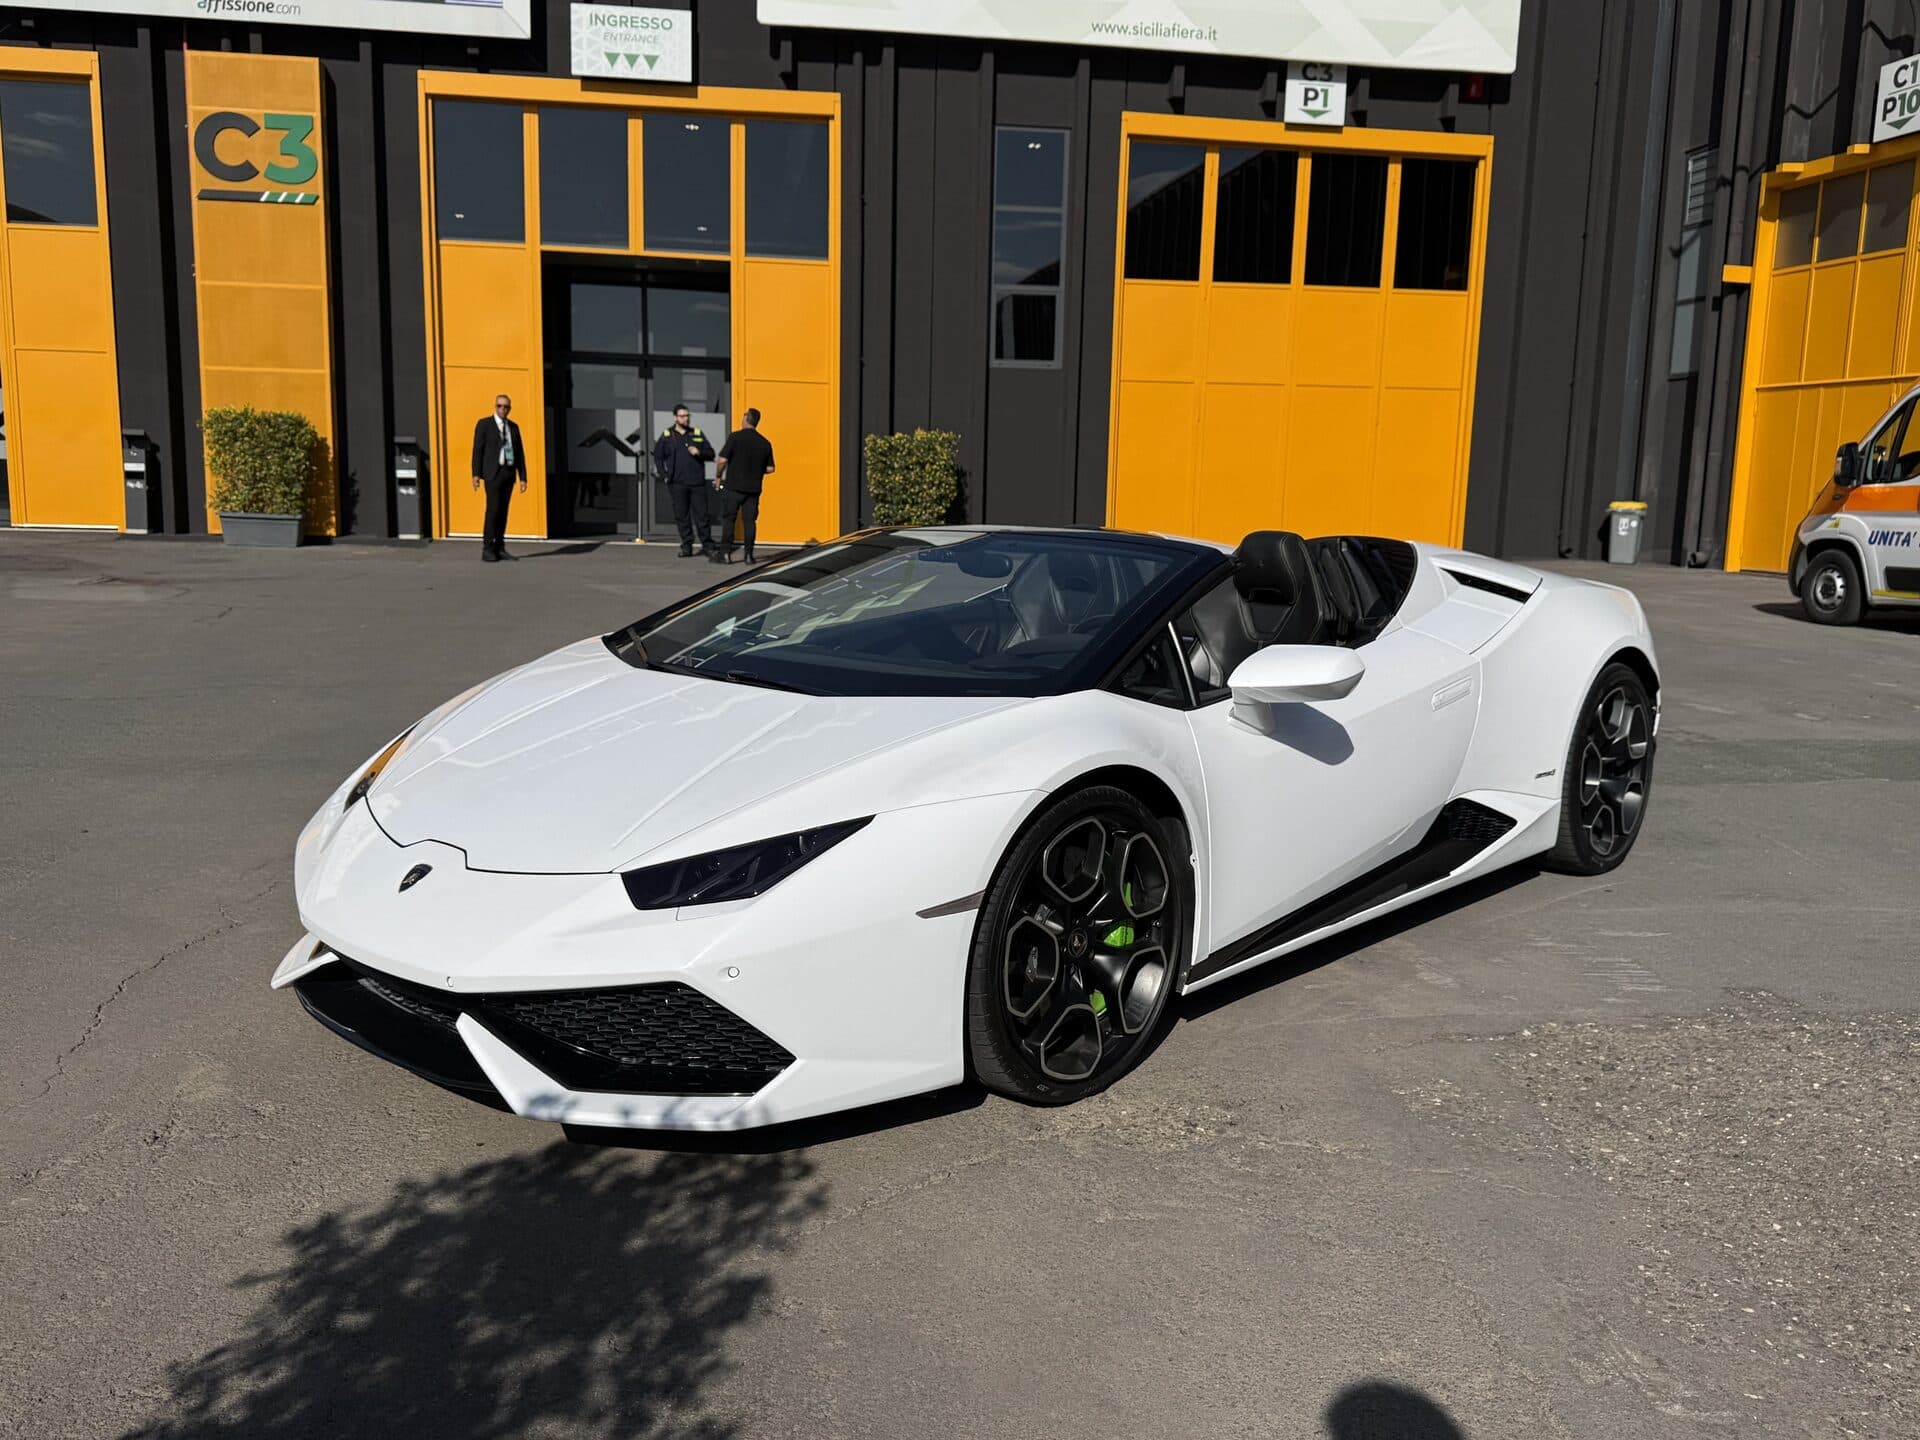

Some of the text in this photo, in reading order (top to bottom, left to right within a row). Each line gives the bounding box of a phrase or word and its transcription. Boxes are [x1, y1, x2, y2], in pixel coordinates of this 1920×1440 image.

[590, 12, 673, 30] INGRESSO
[1091, 21, 1217, 41] www.siciliafiera.it
[603, 32, 660, 44] ENTRANCE
[1302, 63, 1333, 81] C3
[1893, 60, 1919, 88] C1
[1303, 87, 1329, 108] P1
[1882, 88, 1920, 122] P10
[194, 111, 318, 185] C3
[1867, 531, 1918, 547] UNITA'
